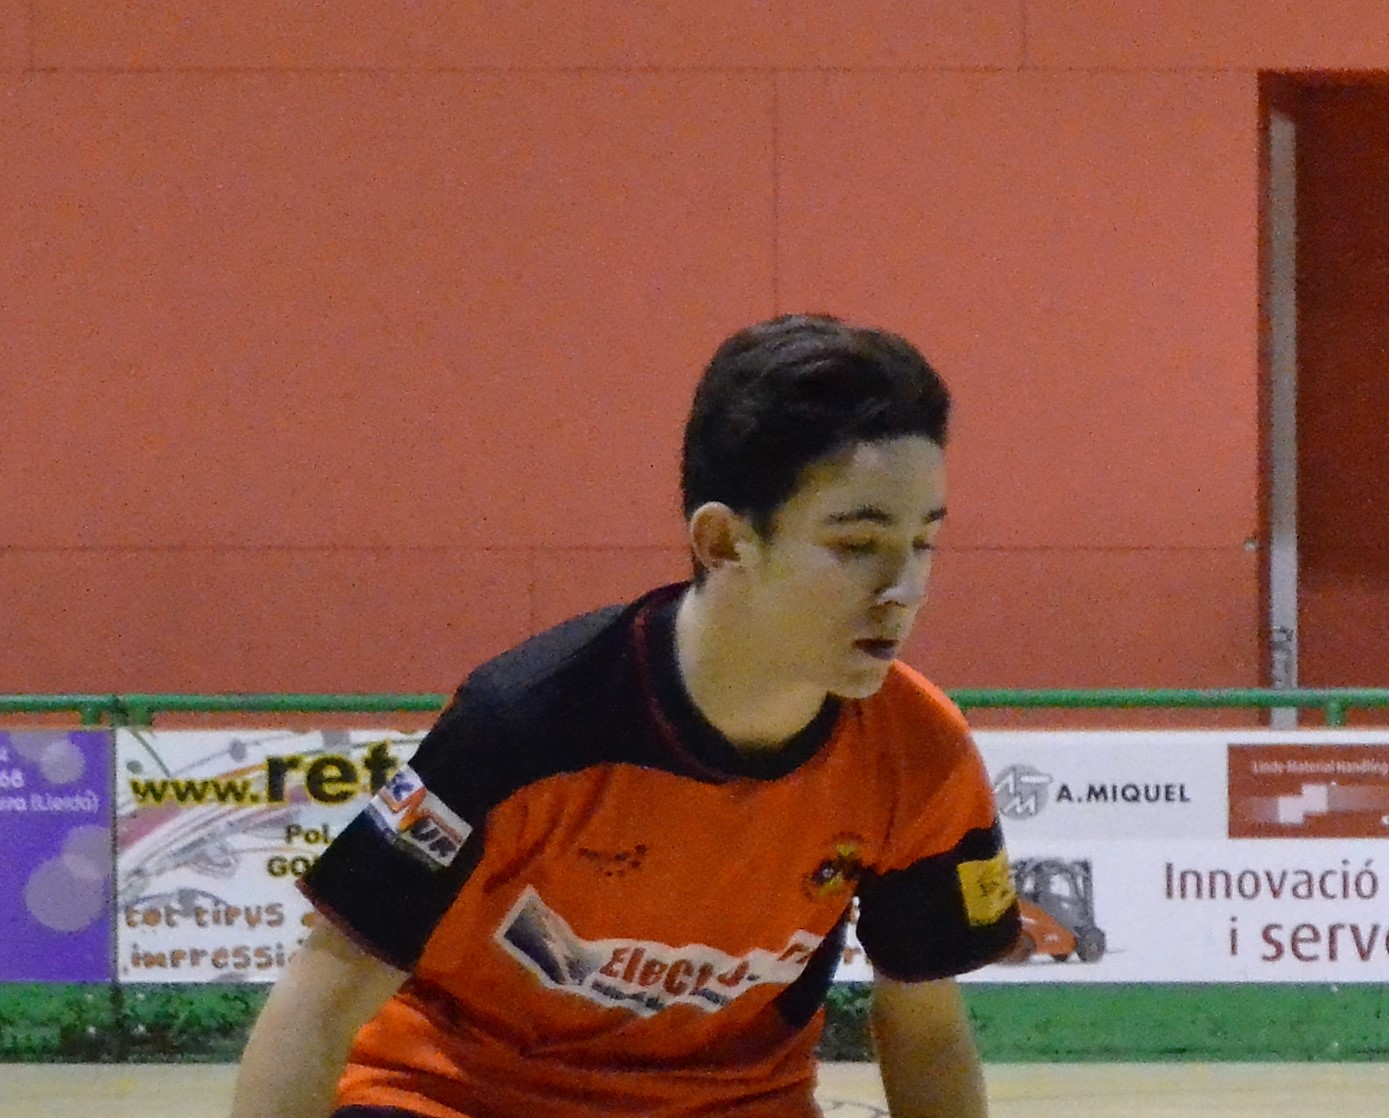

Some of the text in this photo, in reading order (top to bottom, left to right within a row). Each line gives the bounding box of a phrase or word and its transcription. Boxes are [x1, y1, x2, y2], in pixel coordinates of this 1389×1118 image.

[1056, 783, 1191, 804] A.MIQUEL
[267, 855, 322, 877] GO
[1165, 858, 1379, 900] Innovació
[1229, 917, 1239, 956] i
[131, 941, 295, 970] impressi
